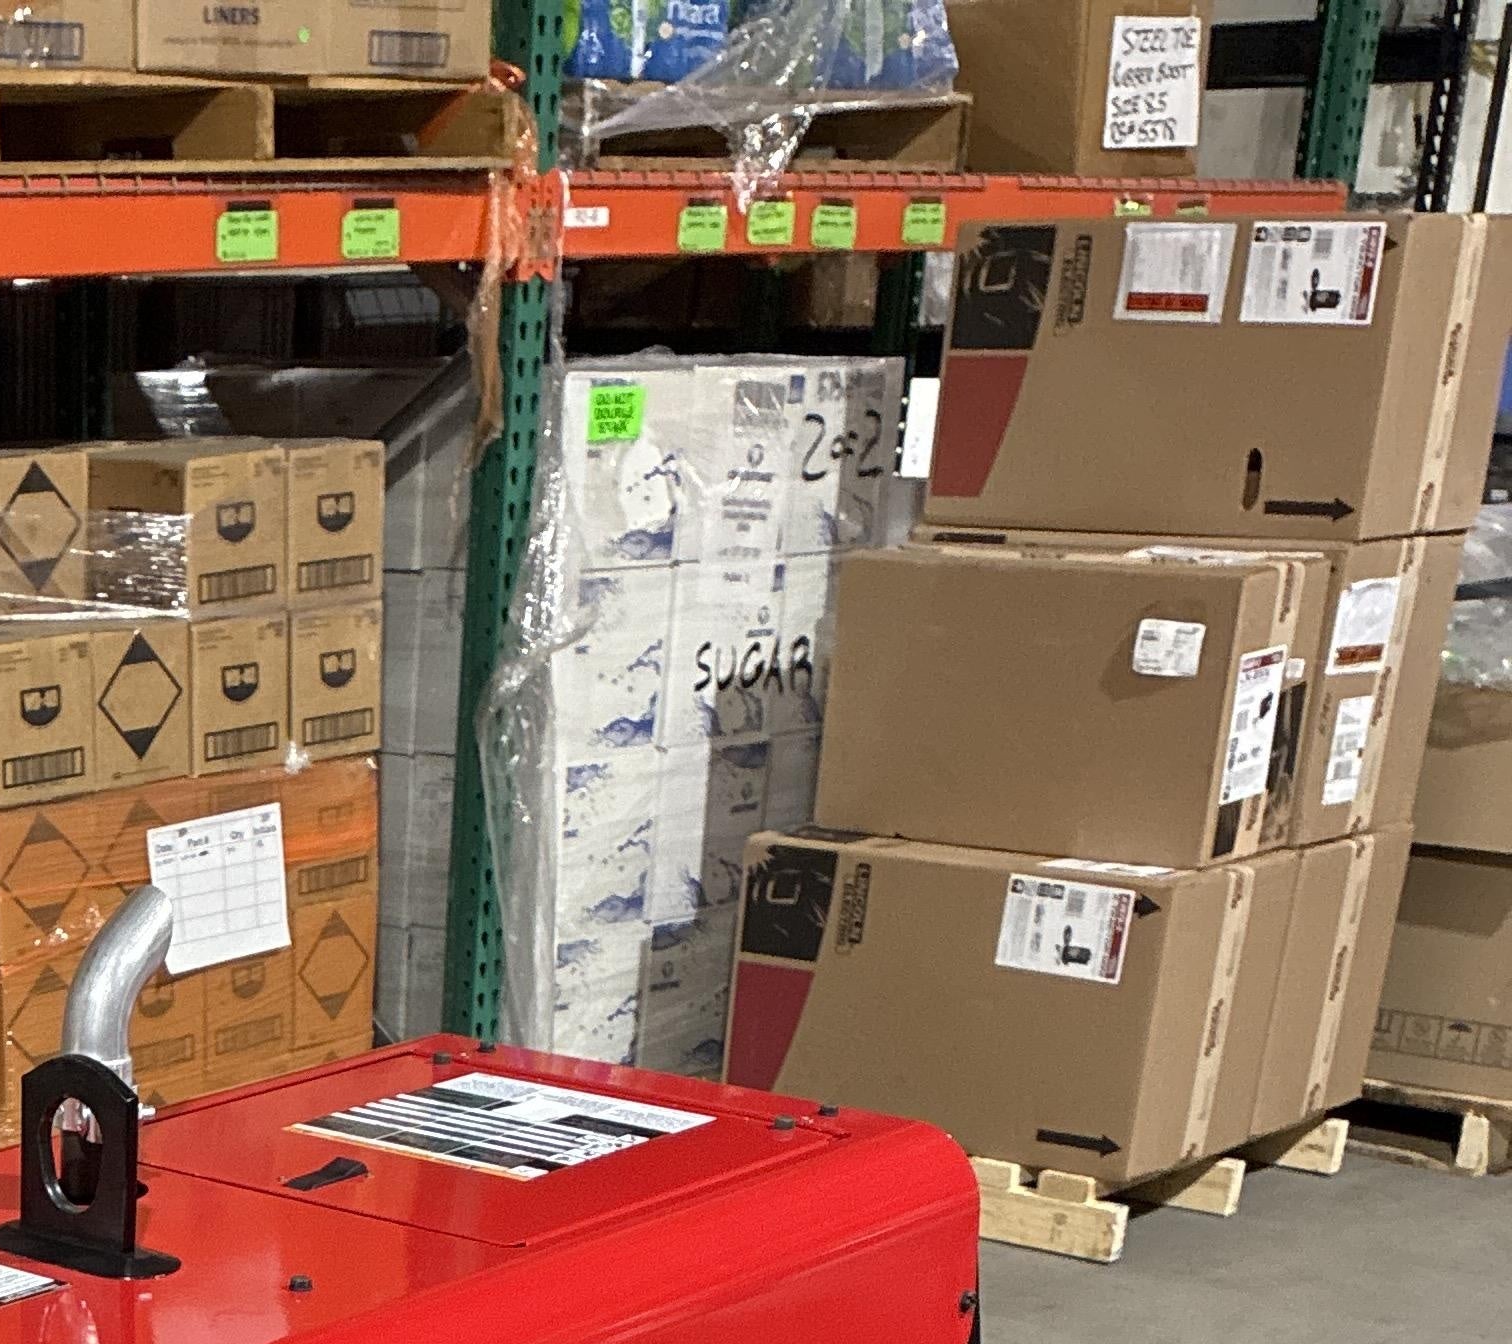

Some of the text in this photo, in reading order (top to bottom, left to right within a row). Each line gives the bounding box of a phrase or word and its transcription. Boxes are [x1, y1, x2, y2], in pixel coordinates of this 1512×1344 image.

[204, 6, 260, 25] LINERS
[801, 412, 827, 482] 2
[857, 408, 884, 479] 2
[693, 634, 814, 693] SUGAR
